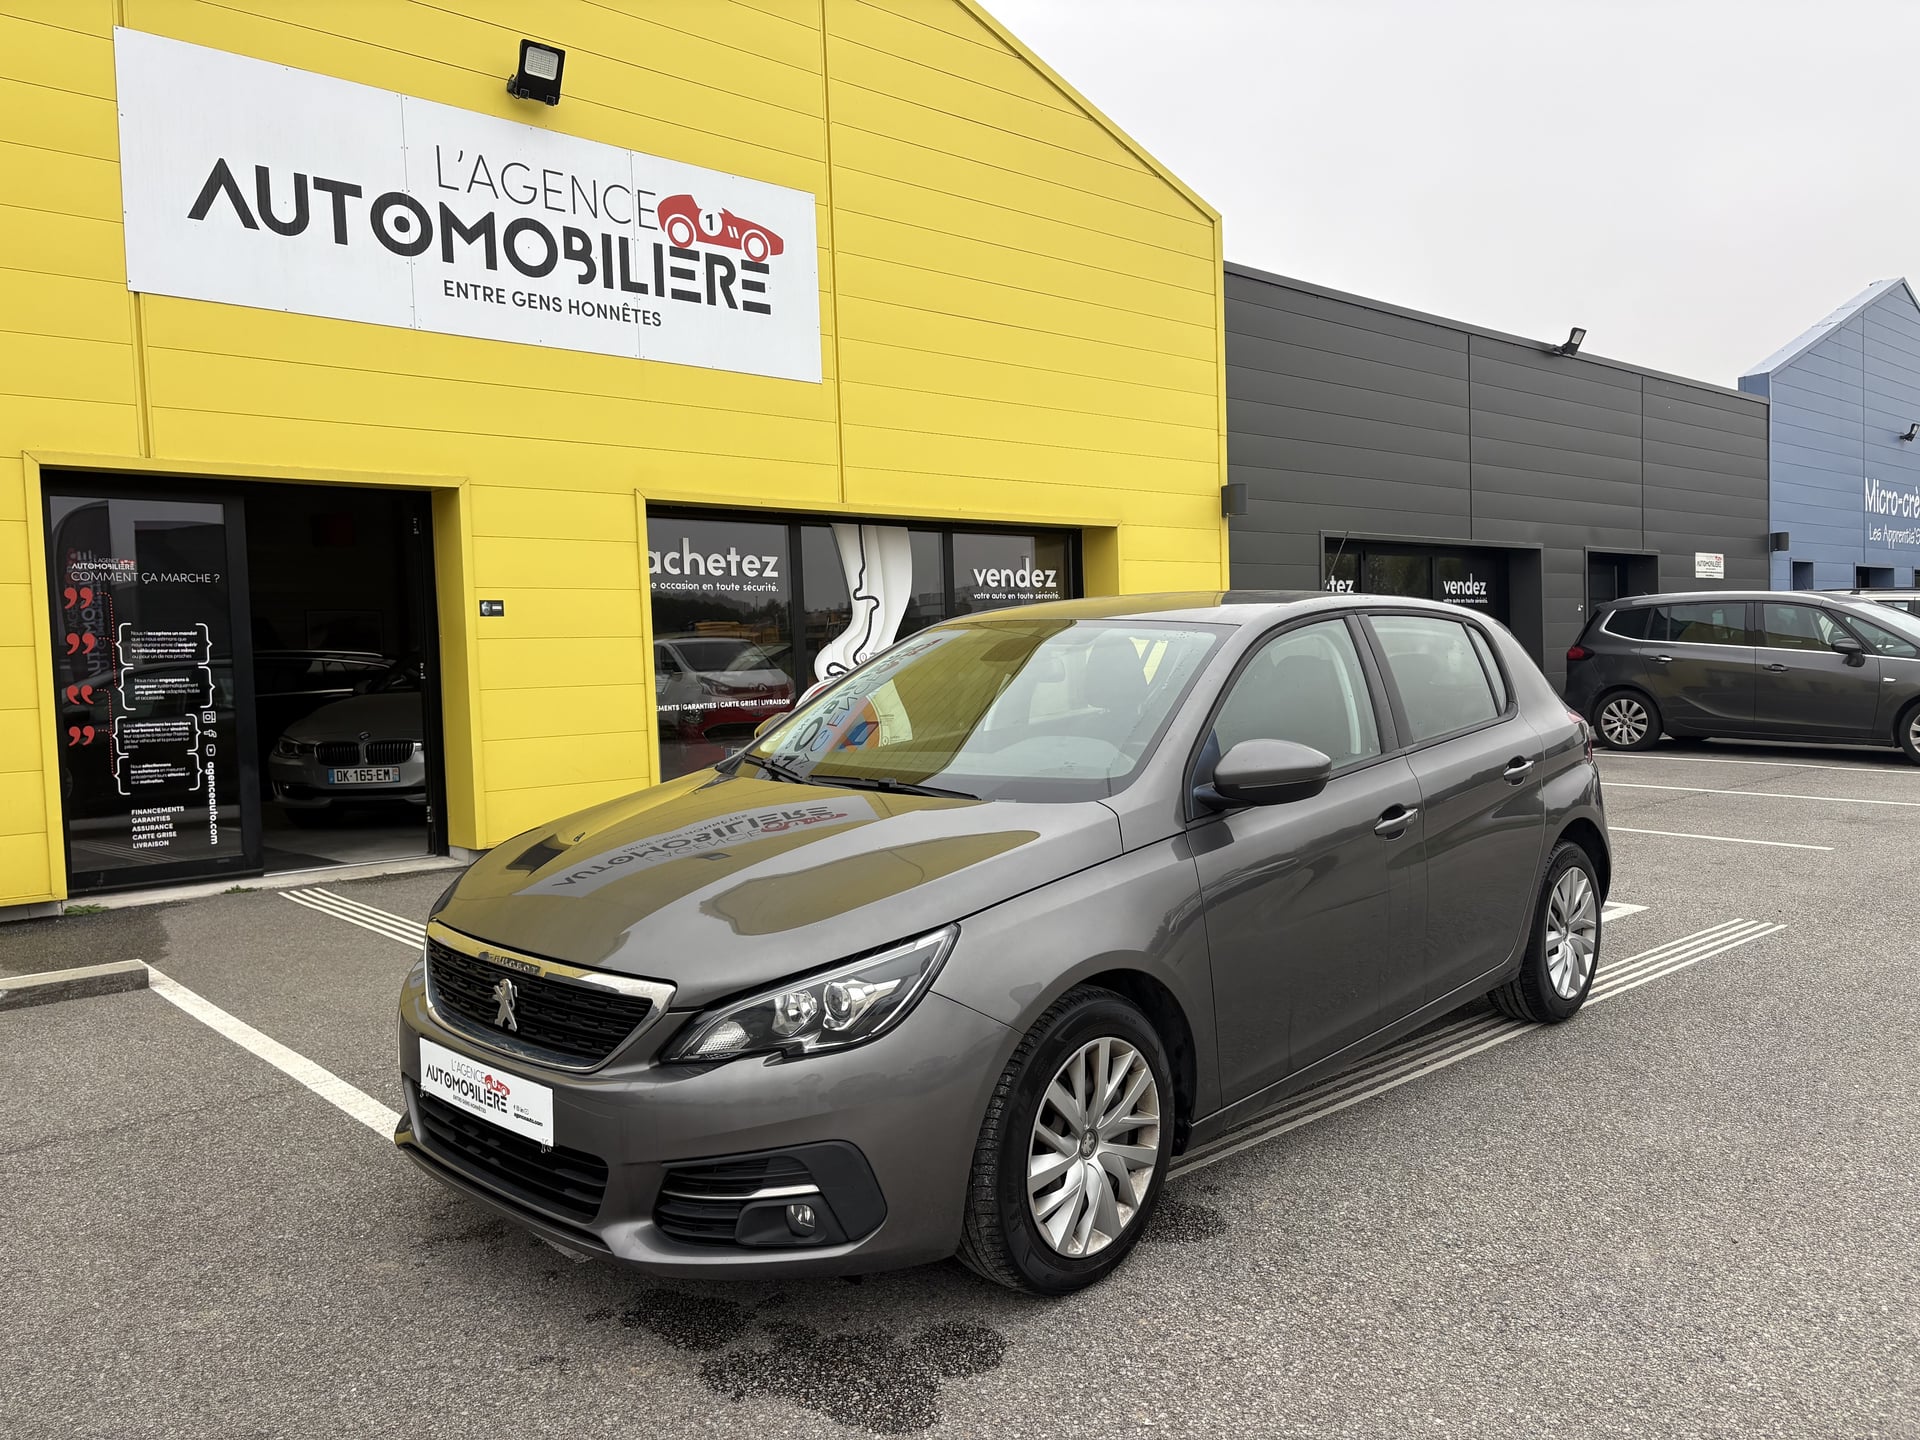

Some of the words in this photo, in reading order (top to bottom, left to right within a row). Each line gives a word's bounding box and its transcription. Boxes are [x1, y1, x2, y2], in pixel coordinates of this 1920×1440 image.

[436, 144, 658, 231] L'AGENCE
[443, 279, 507, 307] ENTRE
[512, 289, 563, 314] GENS
[568, 298, 662, 328] HONNÊTES
[1869, 521, 1882, 541] Les
[648, 537, 779, 578] achetez
[71, 571, 139, 582] COMMENT
[141, 572, 159, 584] ÇA
[160, 573, 211, 583] MARCHE
[214, 574, 221, 583] ?
[973, 557, 1057, 588] vendez
[660, 580, 700, 590] occasion
[702, 582, 713, 590] en
[716, 582, 740, 591] toute
[743, 581, 779, 592] sécurité.
[1443, 573, 1487, 595] vendez
[973, 592, 990, 600] votre
[991, 592, 1007, 600] auto
[1008, 592, 1015, 600] en
[1017, 592, 1034, 600] toute
[1035, 590, 1061, 600] sérénité.
[682, 702, 717, 711] GARANTIES
[720, 701, 740, 709] CARTE
[740, 699, 758, 707] GRISE
[761, 698, 791, 706] LIVRAISON
[336, 768, 391, 782] DK-165-EM
[205, 761, 218, 845] agenceauto.com
[131, 806, 185, 815] FINANCEMENTS
[131, 815, 171, 824] GARANTIES
[131, 823, 174, 832] ASSURANCE
[132, 833, 156, 841] CARTE
[156, 831, 177, 839] GRISE
[132, 840, 170, 849] LIVRAISON
[450, 1058, 486, 1085] L'AGENCE
